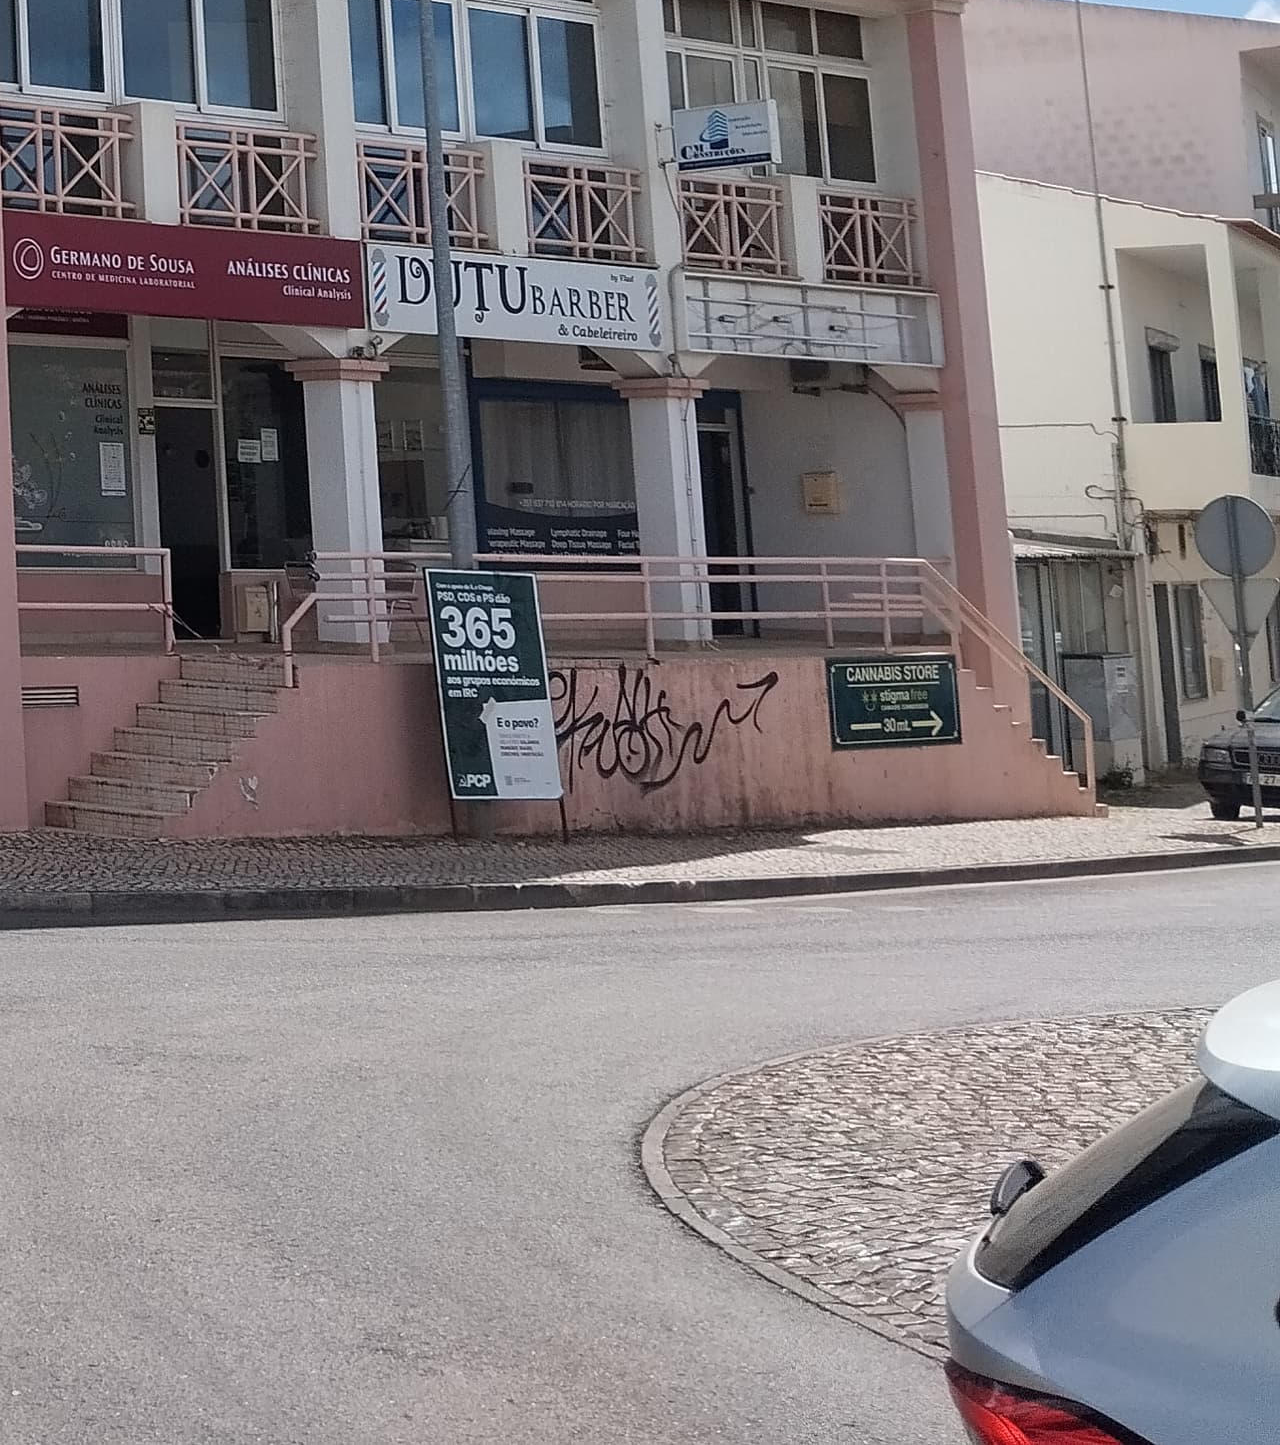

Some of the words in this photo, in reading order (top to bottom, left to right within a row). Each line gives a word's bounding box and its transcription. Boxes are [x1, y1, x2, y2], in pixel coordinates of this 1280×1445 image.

[51, 246, 121, 268] GERMANO
[128, 256, 144, 270] DE
[150, 254, 195, 274] SOUSA
[227, 258, 289, 279] ANÁLISES
[293, 262, 351, 284] CLÍNICAS
[610, 273, 618, 283] by
[52, 271, 82, 281] CENTRO
[86, 273, 95, 281] DE
[99, 274, 137, 285] MEDICINA
[140, 277, 196, 289] LABORATORIAL
[283, 285, 315, 297] Clinical
[317, 288, 352, 300] Analysis
[530, 284, 636, 322] BARBER
[558, 324, 569, 336] &
[572, 324, 638, 342] Cabeleireiro
[437, 592, 456, 602] PSD,
[457, 593, 475, 602] CDS
[483, 593, 494, 603] PS
[495, 593, 511, 604] dão
[440, 606, 516, 649] 365
[443, 649, 519, 672] milhões
[447, 676, 461, 685] aos
[462, 677, 491, 687] grupos
[492, 675, 540, 686] económicos
[846, 665, 902, 682] CANNABIS
[903, 665, 939, 680] STORE
[462, 688, 478, 697] IRC
[496, 718, 503, 728] E
[512, 718, 539, 730] povo?
[883, 718, 896, 733] 30
[466, 774, 491, 788] PCP
